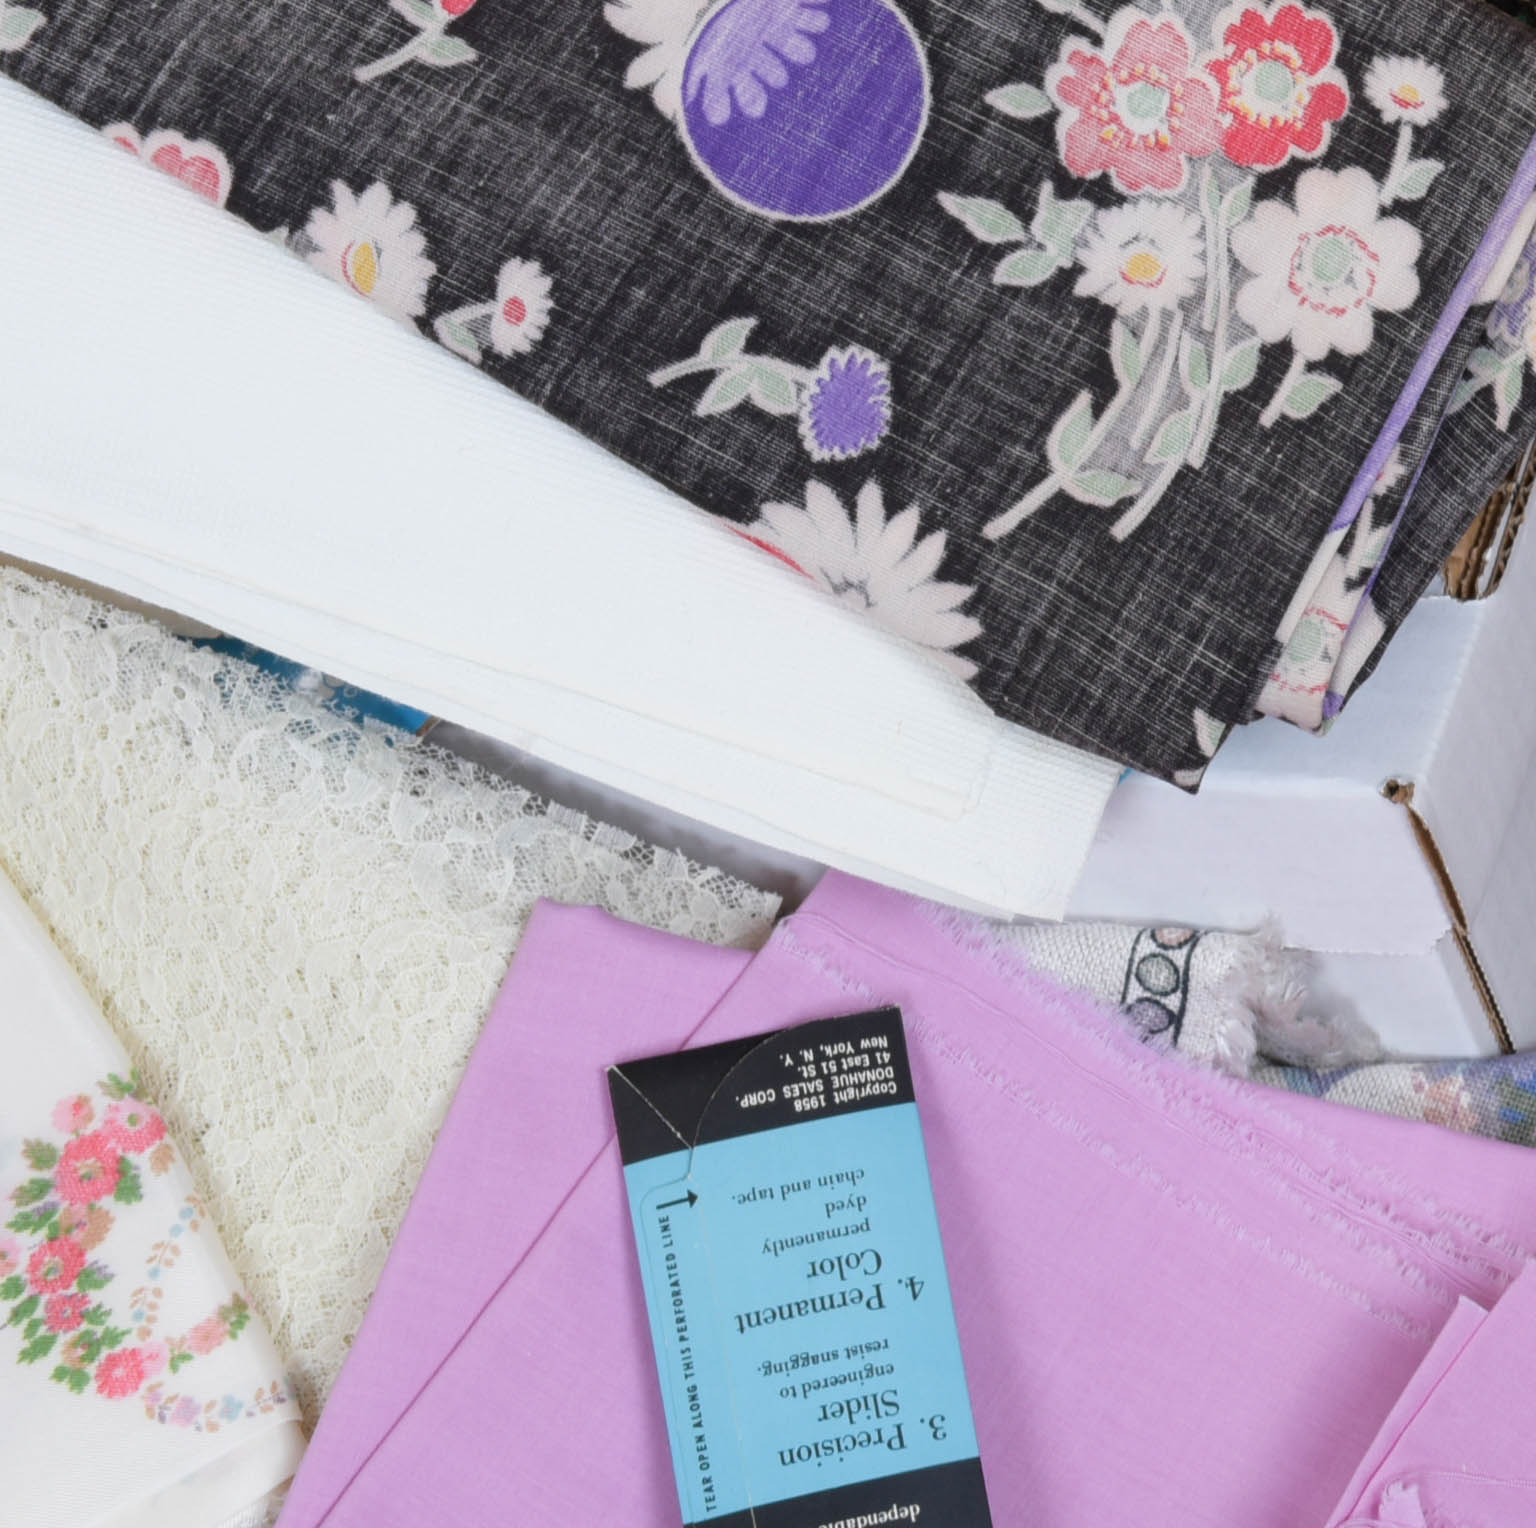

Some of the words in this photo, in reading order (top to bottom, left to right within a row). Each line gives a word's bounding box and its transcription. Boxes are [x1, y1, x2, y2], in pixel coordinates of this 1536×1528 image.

[819, 1041, 855, 1058] York,
[860, 1035, 888, 1049] New
[779, 1053, 794, 1067] Y.
[799, 1048, 814, 1062] N.
[840, 1053, 870, 1071] East
[875, 1051, 891, 1065] 41
[797, 1064, 817, 1079] St.
[820, 1060, 837, 1075] 51
[830, 1066, 894, 1089] DONAHUE
[735, 1088, 776, 1108] CORP.
[782, 1078, 824, 1099] SALES
[833, 1081, 897, 1105] Copyright
[793, 1094, 826, 1113] 1958
[780, 1179, 812, 1200] and
[817, 1169, 865, 1190] chain
[731, 1186, 775, 1205] tape.
[824, 1194, 867, 1219] dyed
[658, 1215, 674, 1249] LINE
[762, 1219, 871, 1257] permanently
[806, 1248, 882, 1282] Color
[664, 1252, 690, 1343] PERFORATED
[897, 1276, 925, 1302] 4.
[735, 1283, 886, 1335] Permanent
[843, 1338, 889, 1361] resist
[679, 1346, 695, 1381] THIS
[757, 1349, 840, 1377] snagging.
[801, 1363, 895, 1397] engineered
[779, 1385, 798, 1399] to
[686, 1384, 704, 1429] ALONG
[817, 1389, 900, 1425] Slider
[919, 1414, 947, 1441] 3.
[694, 1433, 711, 1472] OPEN
[778, 1423, 907, 1468] Precision
[701, 1477, 717, 1513] TEAR
